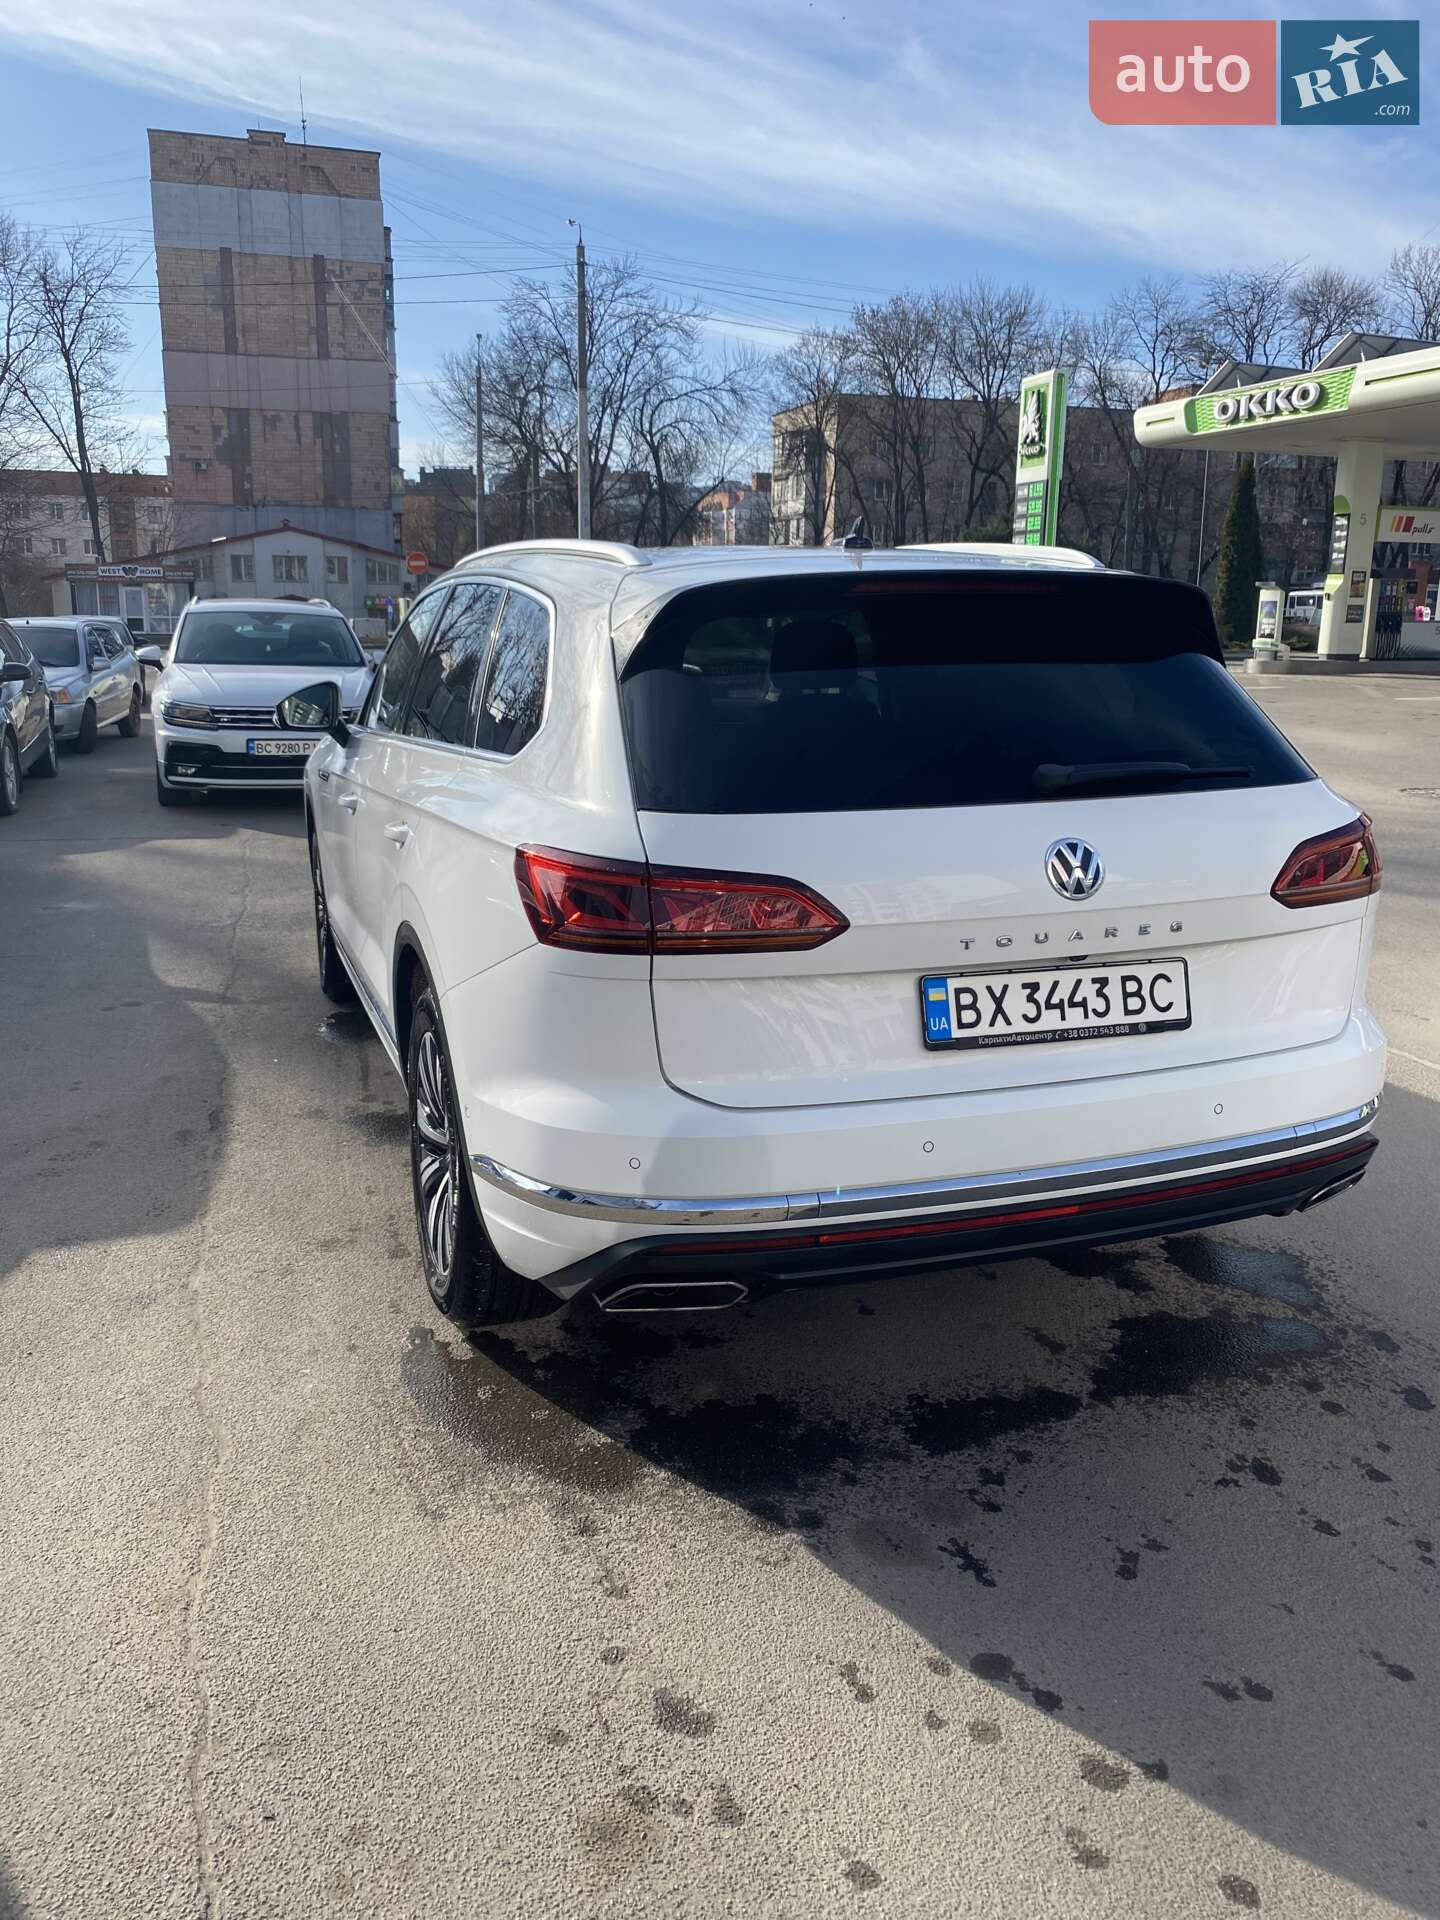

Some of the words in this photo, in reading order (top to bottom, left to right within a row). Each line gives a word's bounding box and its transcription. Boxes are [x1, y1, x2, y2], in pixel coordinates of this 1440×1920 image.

[1214, 382, 1321, 424] OKKO
[1360, 513, 1367, 526] 5
[100, 567, 121, 576] WEST
[140, 567, 162, 576] HOME
[256, 743, 272, 754] BC
[275, 743, 300, 754] 9280
[960, 921, 1183, 950] TOUAREG
[954, 983, 1012, 1030] BX
[1021, 977, 1111, 1024] 3443
[1121, 973, 1174, 1016] BC
[930, 1018, 949, 1031] UA
[1079, 1029, 1098, 1038] 0372
